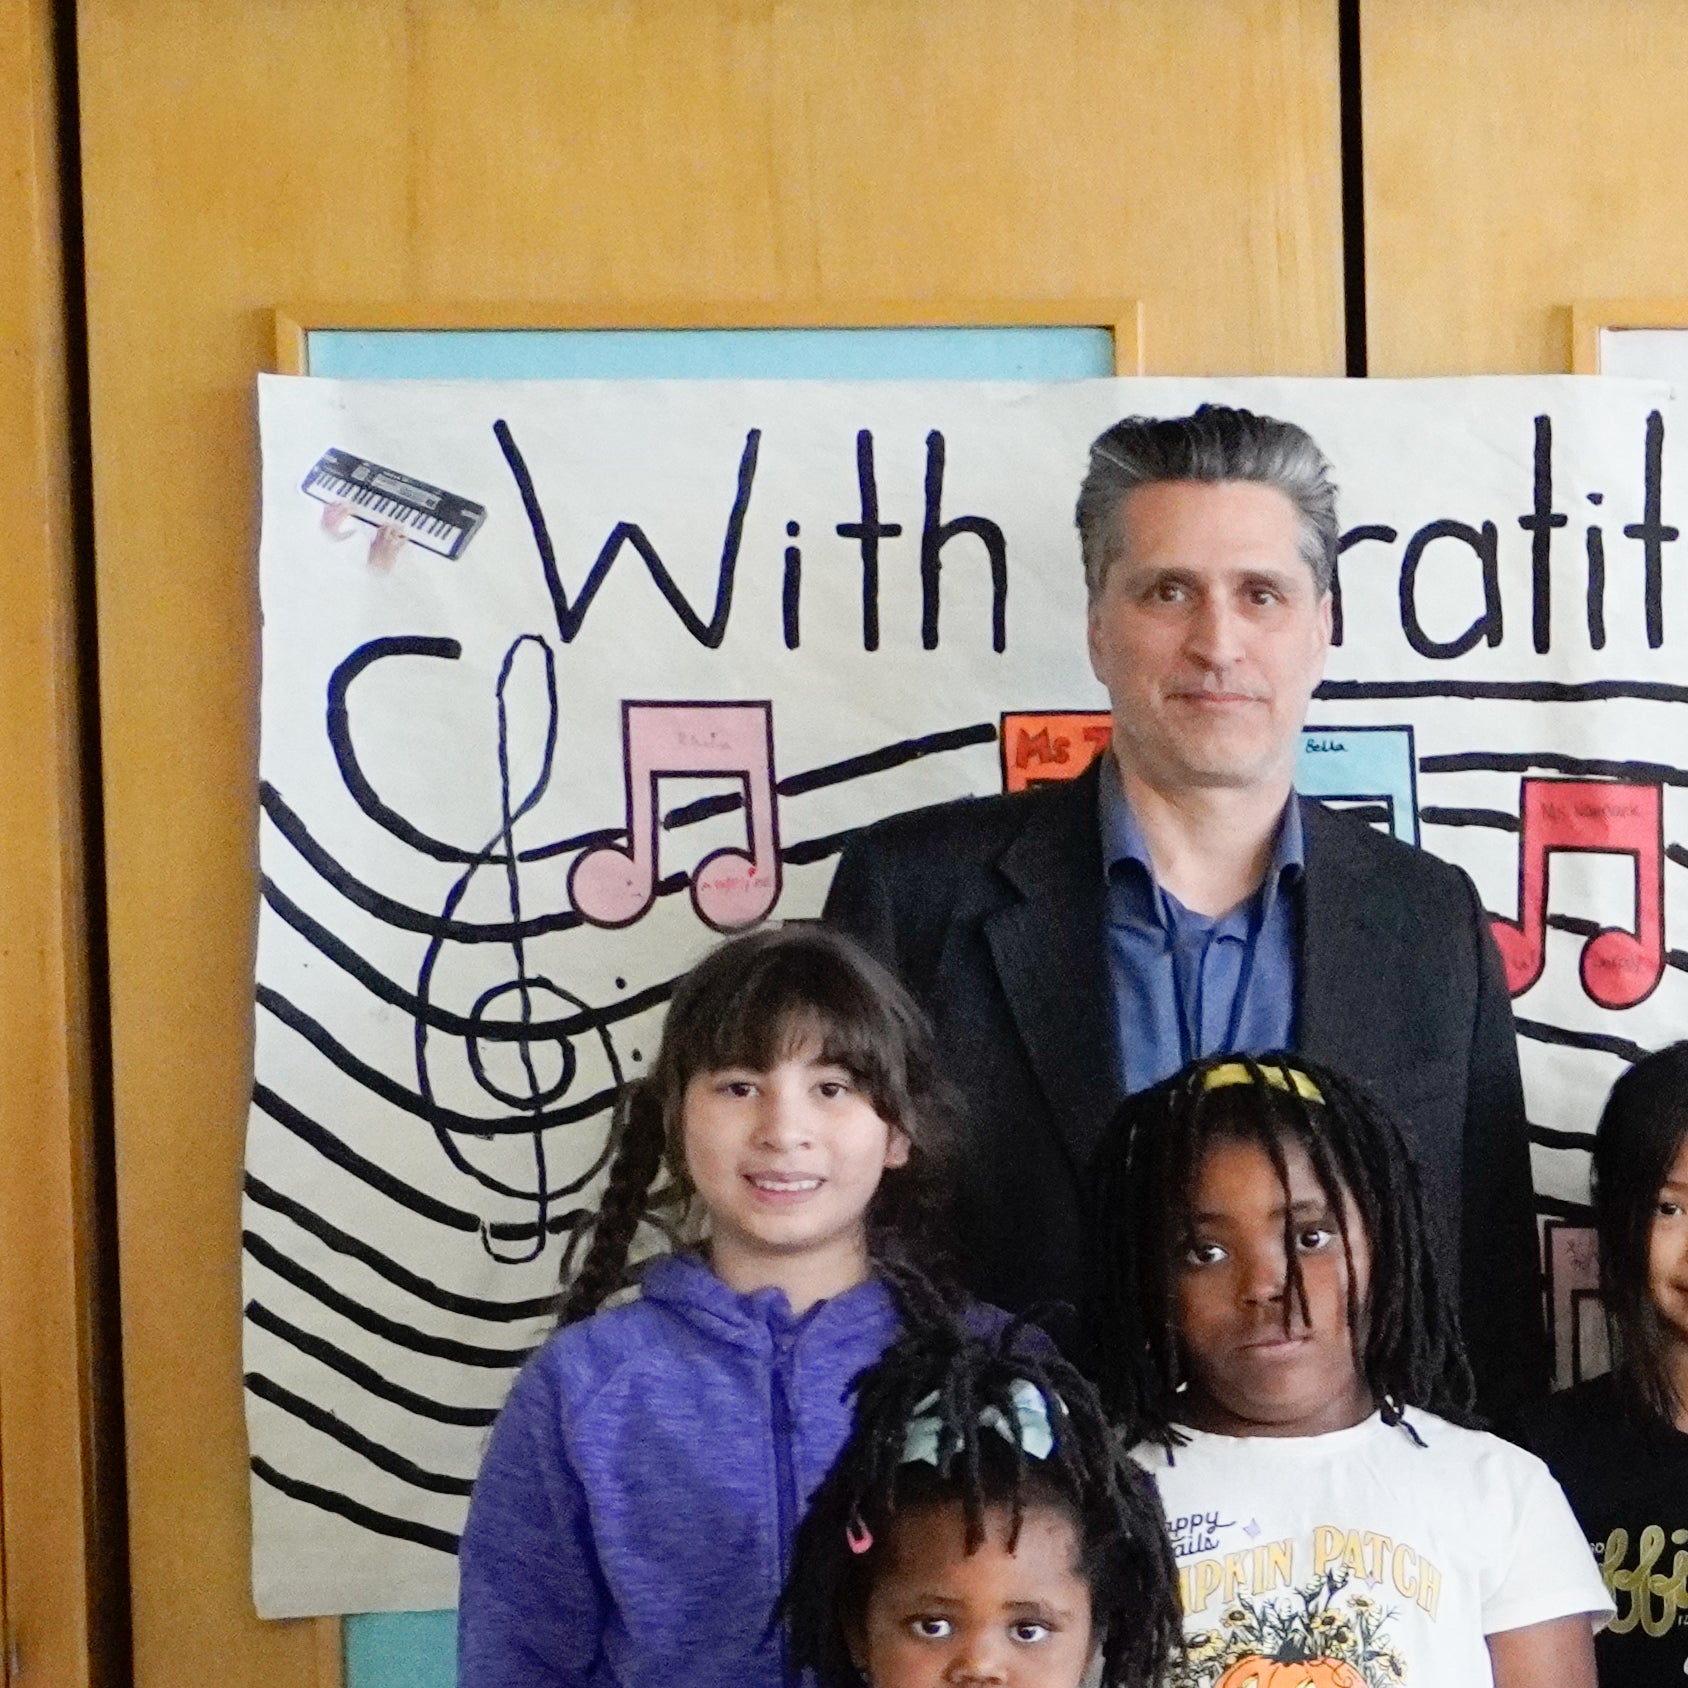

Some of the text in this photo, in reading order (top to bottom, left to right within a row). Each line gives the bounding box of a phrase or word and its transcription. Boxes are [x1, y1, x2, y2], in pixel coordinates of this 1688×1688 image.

[494, 418, 1007, 653] With
[1166, 1510, 1237, 1534] appy
[1312, 1524, 1442, 1623] PATCH
